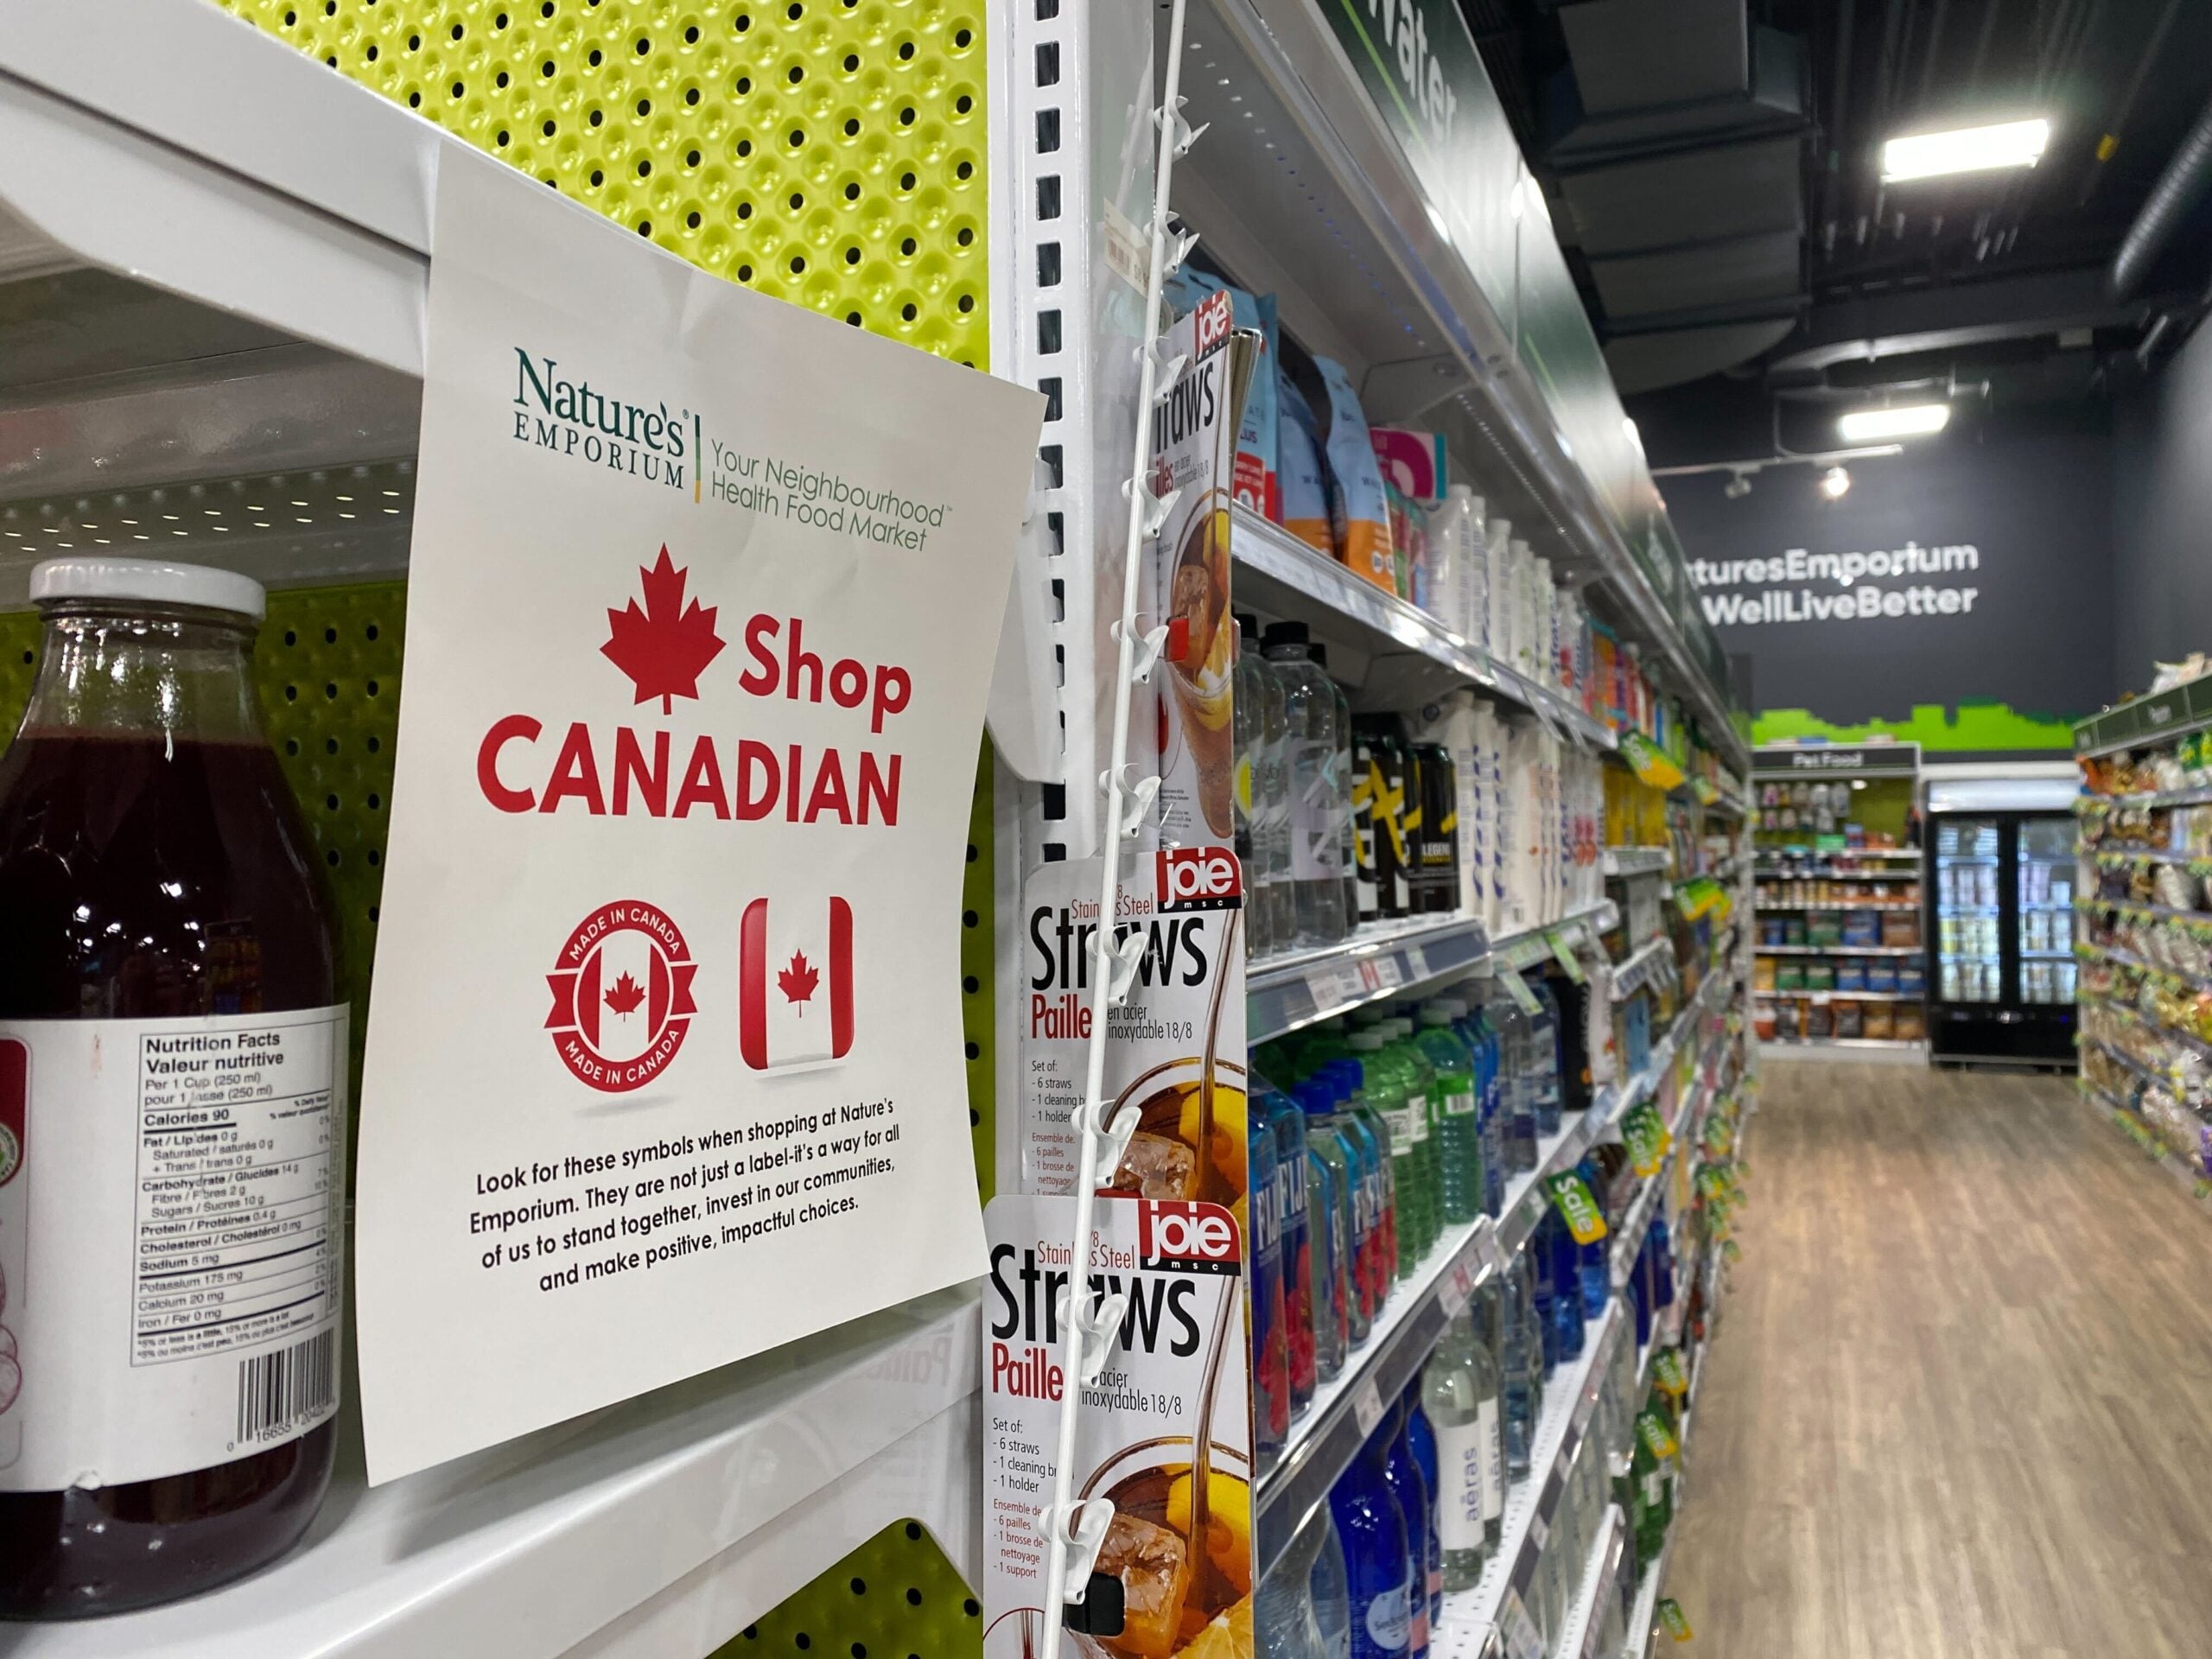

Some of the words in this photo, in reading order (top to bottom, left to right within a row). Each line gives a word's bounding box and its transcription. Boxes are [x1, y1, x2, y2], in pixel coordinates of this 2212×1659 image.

[1198, 294, 1227, 361] joie
[513, 346, 684, 458] Nature's
[513, 411, 684, 489] EMPORIUM
[711, 439, 760, 480] Your
[765, 457, 945, 528] Neighbourhood
[712, 471, 779, 516] Health
[785, 494, 843, 532] Food
[849, 512, 928, 551] Market
[738, 613, 912, 734] Shop
[1822, 751, 1863, 767] Food
[477, 714, 901, 826] CANADIAN
[1165, 847, 1234, 910] joie
[1123, 892, 1154, 916] Steel
[569, 916, 607, 961] MADE
[610, 907, 626, 925] IN
[631, 907, 681, 954] CANADA
[1030, 906, 1207, 990] Strws
[1108, 1007, 1120, 1020] en
[1123, 1002, 1147, 1021] acier
[1108, 1020, 1165, 1043] inoxydable
[1166, 1021, 1192, 1044] 18/8
[145, 1037, 231, 1054] Nutrition
[238, 1033, 281, 1049] Facts
[146, 1058, 209, 1074] Valeur
[214, 1052, 283, 1071] nutritive
[564, 1039, 603, 1081] MADE
[606, 1070, 621, 1084] IN
[626, 1029, 679, 1082] CANADA
[1032, 1060, 1045, 1072] Set
[1047, 1059, 1058, 1072] of:
[145, 1080, 167, 1090] Per
[184, 1077, 211, 1090] Cup
[214, 1074, 241, 1088] (250
[244, 1072, 262, 1084] ml)
[1037, 1077, 1043, 1089] 6
[1045, 1077, 1072, 1089] straws
[144, 1094, 174, 1107] pour
[228, 1087, 253, 1101] (250
[256, 1084, 273, 1096] ml)
[1044, 1093, 1077, 1109] cleaning
[144, 1110, 208, 1127] Calories
[212, 1109, 229, 1122] 90
[1046, 1110, 1071, 1122] holder
[143, 1137, 162, 1148] Fat
[476, 1167, 527, 1195] Look
[531, 1162, 558, 1185] for
[563, 1154, 616, 1179] these
[621, 1135, 695, 1169] symbols
[698, 1129, 743, 1151] when
[747, 1113, 817, 1142] shopping
[822, 1107, 836, 1127] at
[840, 1097, 893, 1123] Nature's
[1032, 1132, 1064, 1143] Ensemble
[153, 1147, 209, 1161] Saturated
[1042, 1147, 1065, 1158] pailles
[164, 1161, 198, 1173] Trans
[207, 1157, 233, 1169] trans
[235, 1166, 279, 1182] Glucides
[1042, 1160, 1065, 1171] brosse
[1065, 1162, 1075, 1172] de
[470, 1198, 580, 1234] Emporium.
[585, 1184, 629, 1211] They
[634, 1181, 665, 1198] are
[670, 1170, 697, 1191] not
[700, 1162, 730, 1189] just
[734, 1162, 745, 1176] a
[748, 1144, 813, 1173] label-it's
[817, 1143, 828, 1158] a
[831, 1136, 860, 1161] way
[863, 1128, 882, 1148] for
[885, 1124, 899, 1143] all
[151, 1205, 194, 1218] Sugars
[204, 1198, 241, 1211] Sucres
[152, 1192, 182, 1205] Fibre
[1556, 1176, 1594, 1233] Sale
[481, 1246, 502, 1269] of
[508, 1243, 531, 1262] us
[537, 1233, 556, 1255] to
[563, 1219, 616, 1250] stand
[620, 1202, 702, 1239] together,
[706, 1187, 753, 1216] invest
[756, 1182, 771, 1203] in
[775, 1179, 799, 1198] our
[804, 1157, 895, 1192] communities,
[141, 1222, 186, 1236] Protein
[197, 1215, 251, 1230] Protéines
[1147, 1198, 1232, 1267] joie
[140, 1236, 212, 1255] Cholesterol
[221, 1225, 280, 1244] Cholestérol
[539, 1262, 579, 1292] and
[585, 1251, 639, 1281] make
[645, 1231, 717, 1267] positive,
[721, 1208, 795, 1243] impactful
[798, 1195, 859, 1224] choices.
[140, 1258, 188, 1273] Sodium
[202, 1254, 219, 1265] mg
[1100, 1244, 1135, 1269] Steel
[139, 1277, 200, 1294] Potassium
[204, 1274, 224, 1284] 175
[226, 1271, 243, 1282] mg
[138, 1298, 187, 1312] Calcium
[189, 1294, 205, 1305] 20
[207, 1291, 224, 1303] mg
[990, 1243, 1200, 1357] Strws
[138, 1318, 161, 1329] Iron
[173, 1313, 190, 1325] Fer
[205, 1309, 221, 1321] mg
[1099, 1369, 1128, 1391] acier
[1082, 1387, 1148, 1413] inoxydable
[1151, 1394, 1182, 1418] 18/8
[993, 1417, 1008, 1432] Set
[1010, 1420, 1023, 1433] of:
[1000, 1438, 1006, 1451] 6
[1008, 1440, 1039, 1455] straws
[1007, 1457, 1046, 1478] cleaning
[1008, 1475, 1039, 1493] holder
[994, 1499, 1031, 1516] Ensemble
[1006, 1516, 1031, 1531] pailles
[1006, 1531, 1032, 1547] brosse
[1034, 1536, 1043, 1549] de
[1001, 1547, 1040, 1565] nettoyage
[1006, 1564, 1037, 1580] support
